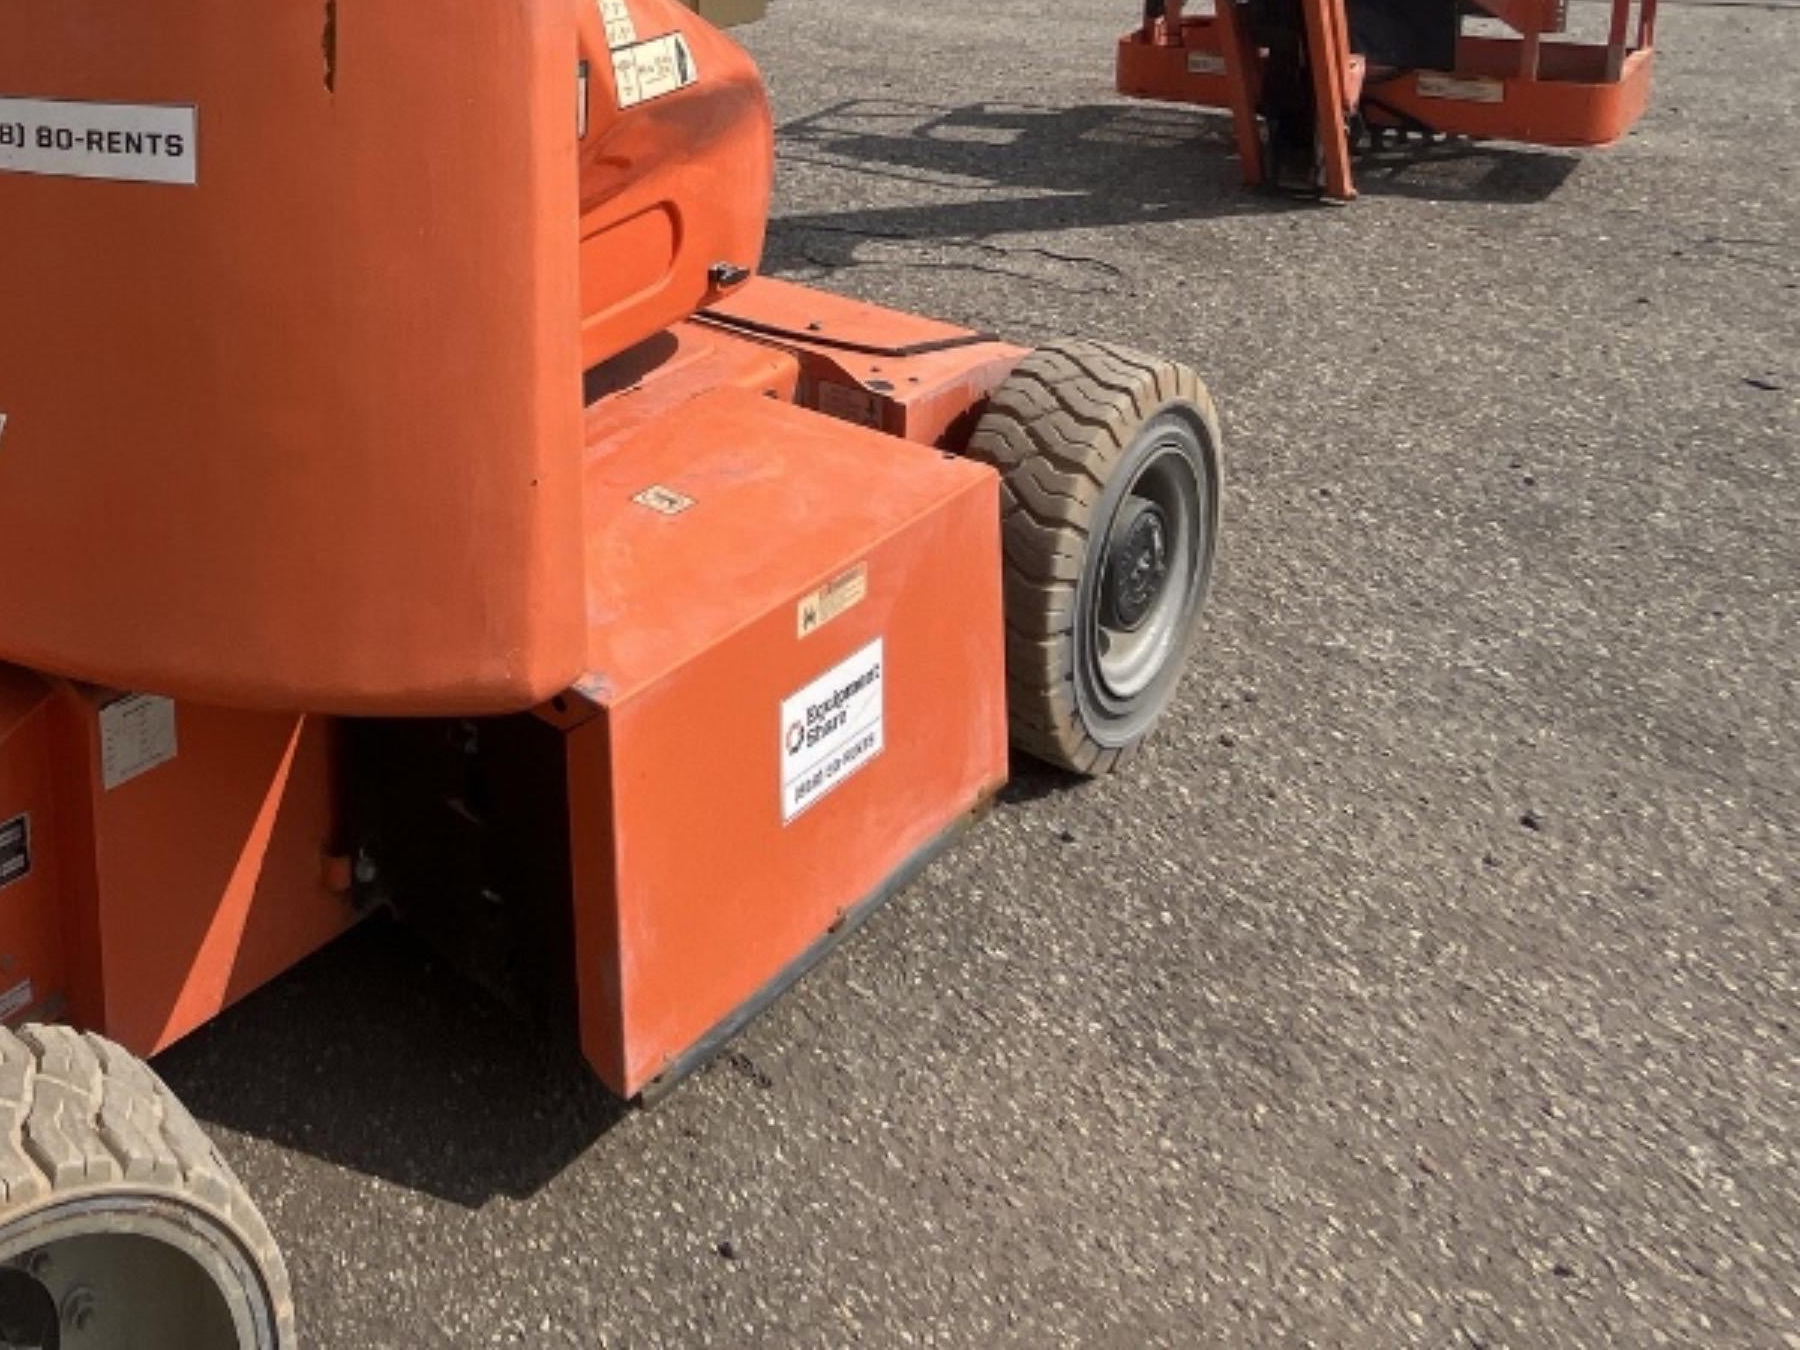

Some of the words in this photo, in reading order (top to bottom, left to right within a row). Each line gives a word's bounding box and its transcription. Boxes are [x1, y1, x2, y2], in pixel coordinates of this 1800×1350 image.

[36, 125, 184, 157] 80-RENTS
[805, 662, 881, 727] Equipment
[805, 709, 848, 748] Share
